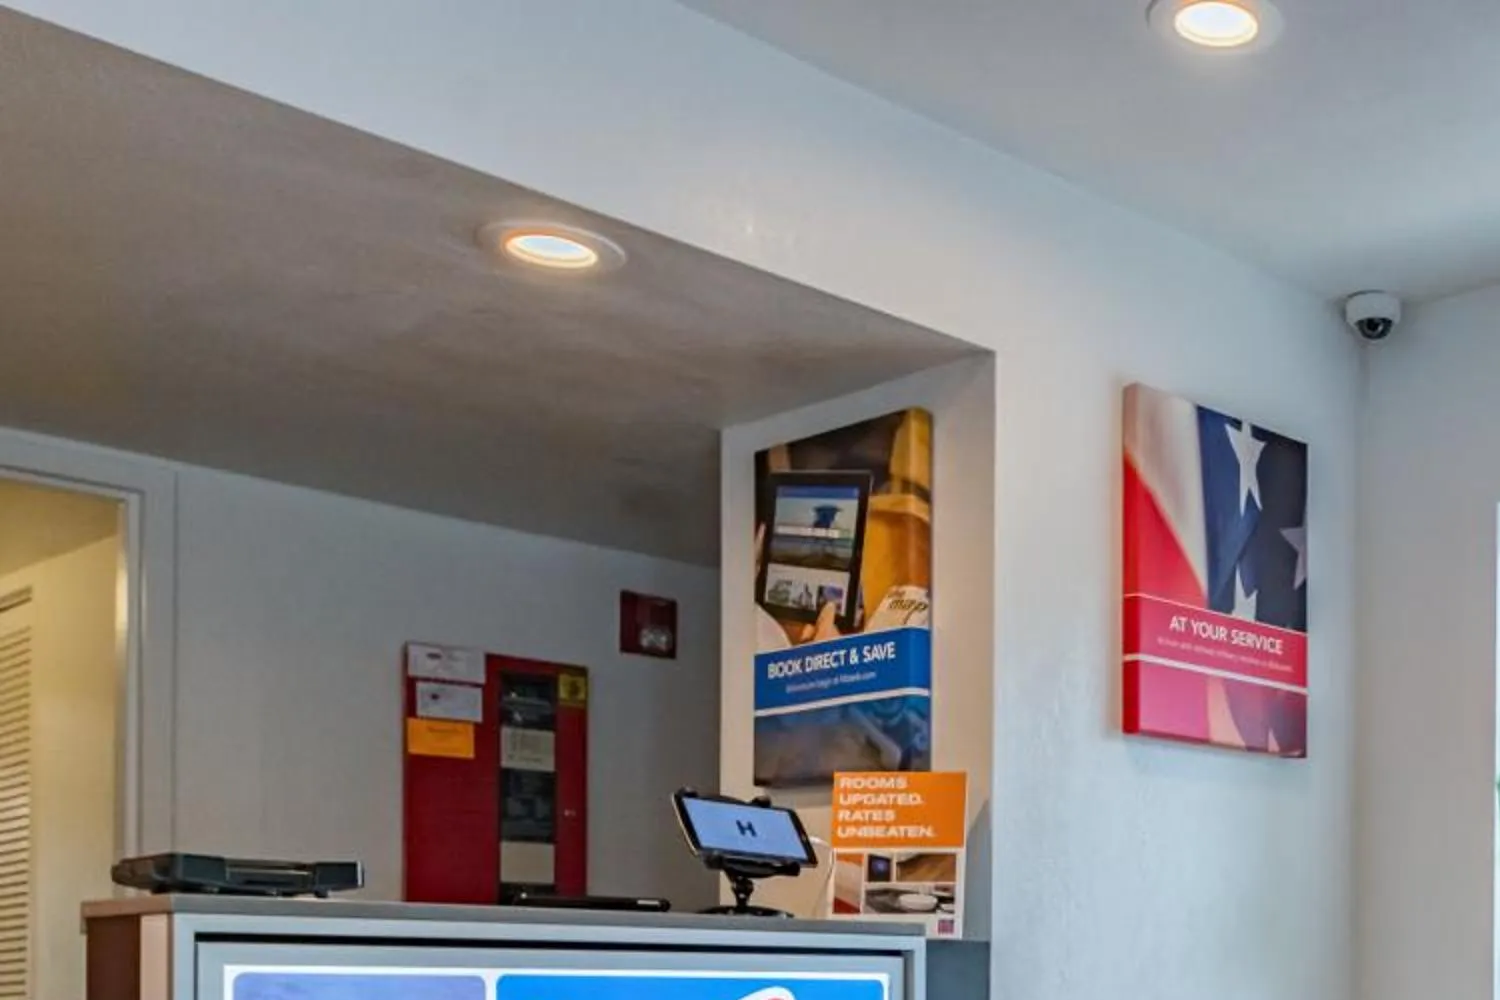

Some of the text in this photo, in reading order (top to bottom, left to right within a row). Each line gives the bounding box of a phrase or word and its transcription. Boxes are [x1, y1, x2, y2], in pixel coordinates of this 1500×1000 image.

[1169, 615, 1188, 632] AT
[1191, 619, 1228, 641] YOUR
[1231, 629, 1283, 655] SERVICE
[767, 641, 896, 679] BOOK DIRECT & SAVE
[840, 776, 908, 790] ROOMS
[838, 808, 896, 822] RATES
